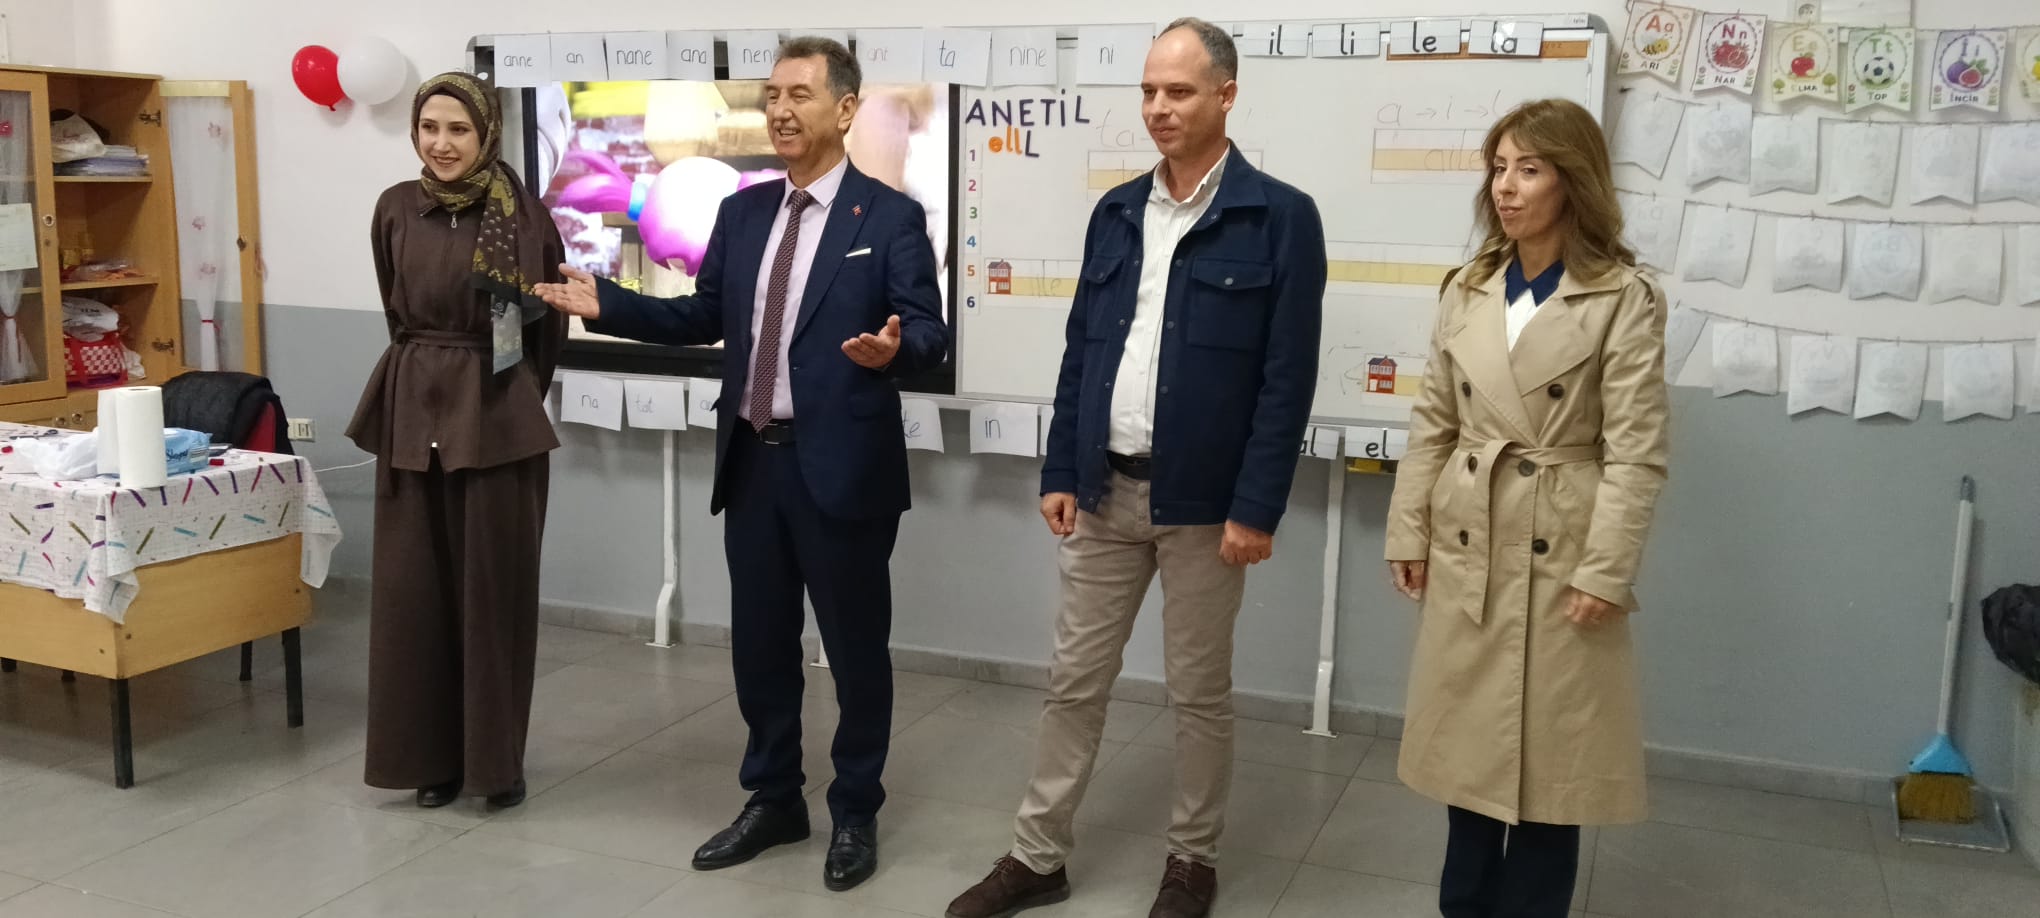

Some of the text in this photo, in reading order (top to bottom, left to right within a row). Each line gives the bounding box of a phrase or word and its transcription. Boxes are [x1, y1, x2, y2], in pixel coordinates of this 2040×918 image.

[1269, 24, 1284, 56] il
[1340, 23, 1355, 56] li
[1412, 20, 1438, 53] le
[1490, 20, 1518, 54] la
[503, 54, 533, 68] anne
[566, 52, 585, 64] an
[616, 48, 653, 66] nane
[680, 48, 708, 65] ana
[939, 39, 956, 68] ta
[1009, 46, 1047, 68] nine
[1099, 45, 1114, 66] ni
[970, 149, 976, 162] 1
[968, 179, 977, 192] 2
[969, 207, 978, 219] 3
[966, 235, 977, 248] 4
[967, 265, 975, 277] 5
[966, 296, 976, 308] 6
[581, 394, 599, 409] na
[984, 416, 1001, 439] in
[1365, 429, 1390, 459] el
